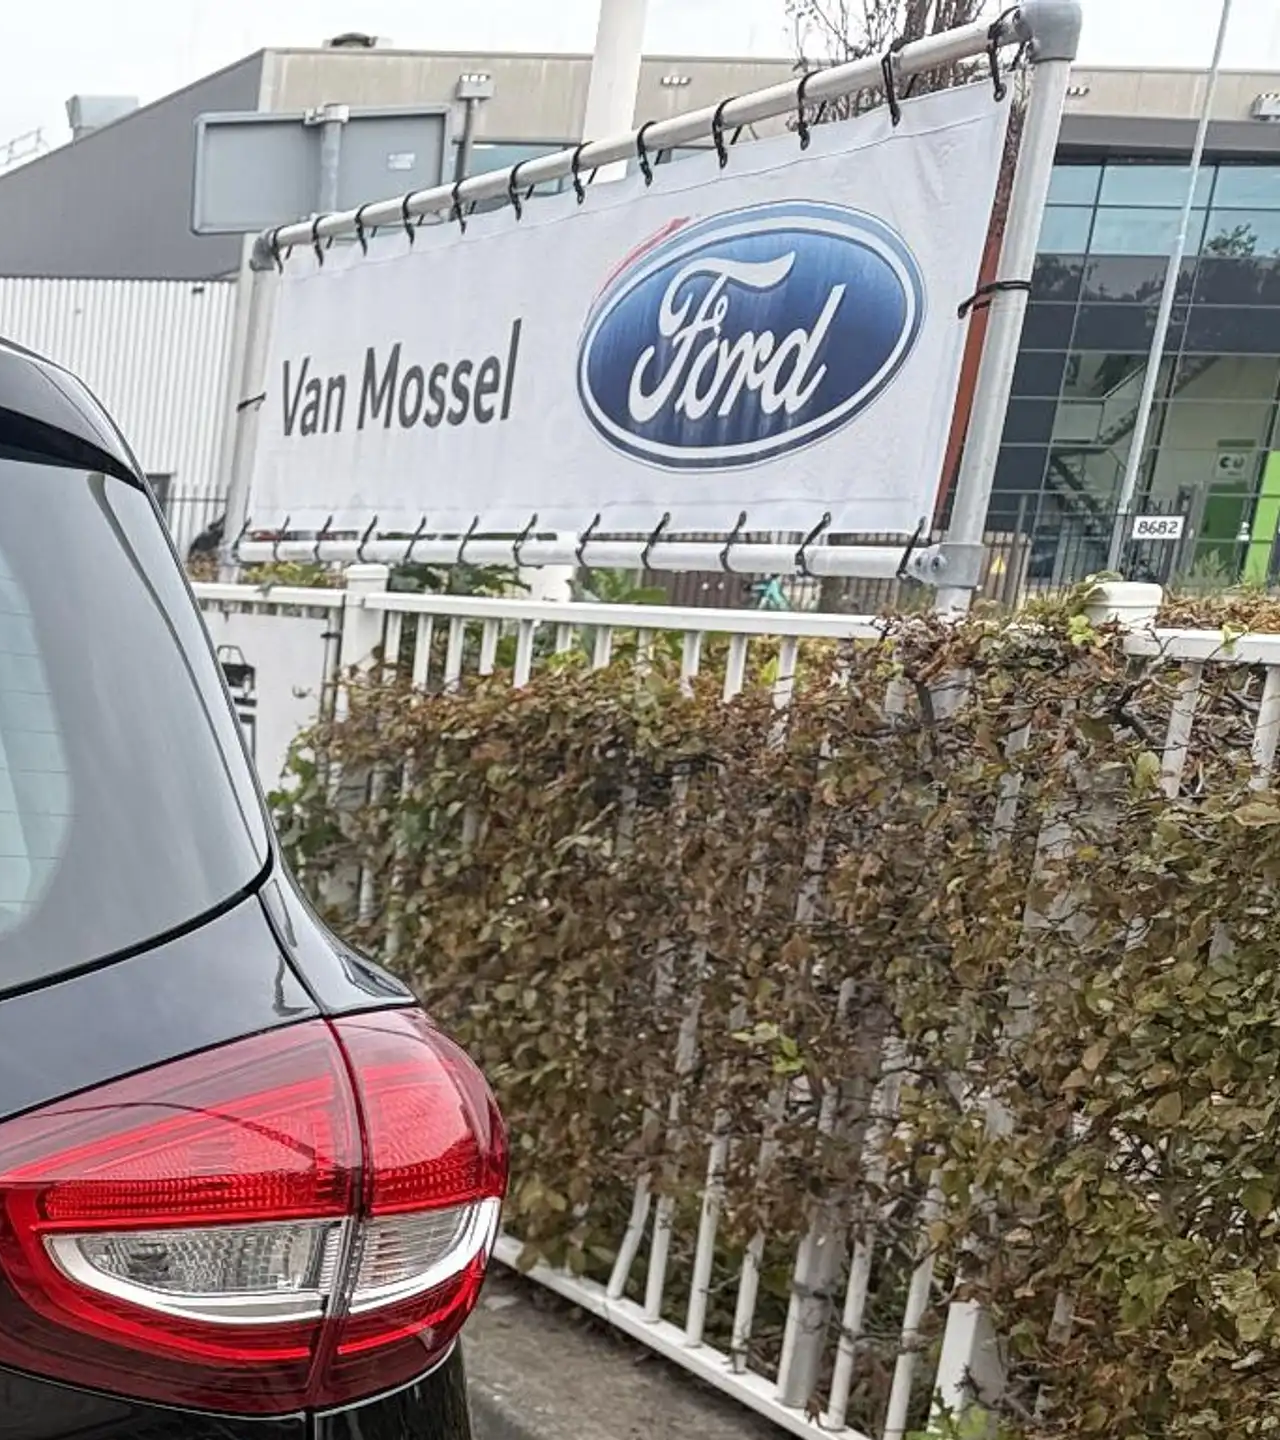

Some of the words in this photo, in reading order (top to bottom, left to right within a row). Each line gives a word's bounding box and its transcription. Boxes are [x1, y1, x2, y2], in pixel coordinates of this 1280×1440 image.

[282, 355, 347, 437] Van
[356, 318, 523, 431] Mossel
[627, 250, 848, 424] Ford
[1137, 520, 1179, 535] 8682
